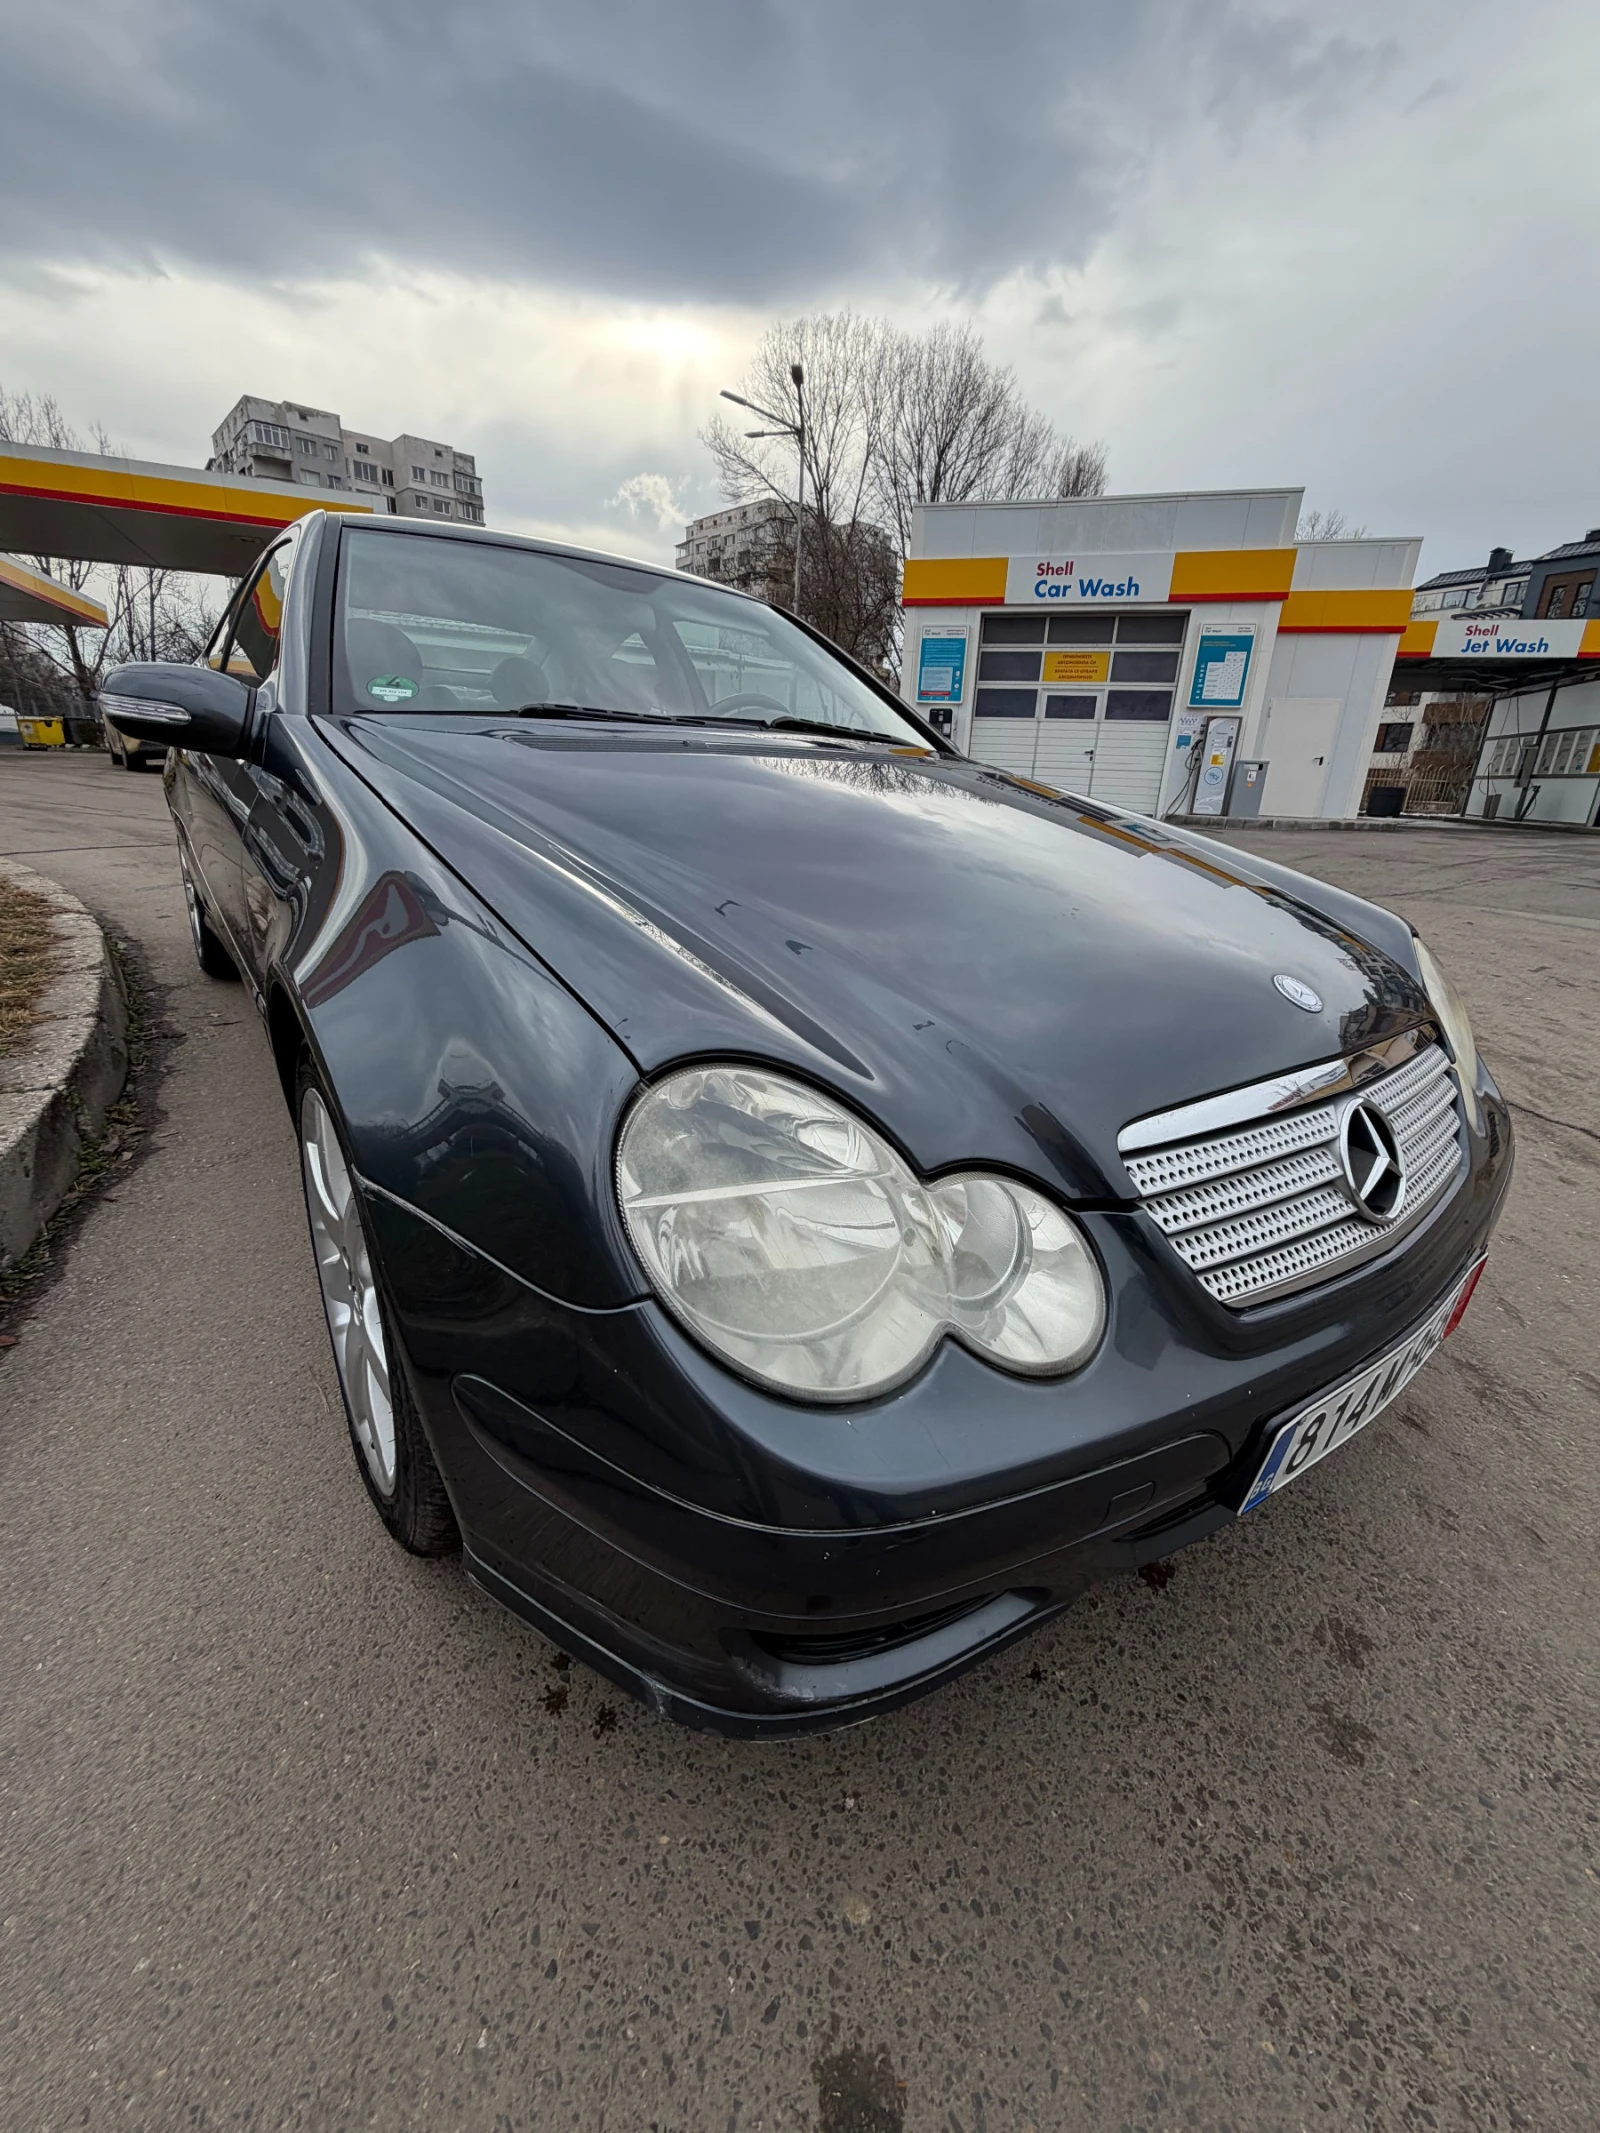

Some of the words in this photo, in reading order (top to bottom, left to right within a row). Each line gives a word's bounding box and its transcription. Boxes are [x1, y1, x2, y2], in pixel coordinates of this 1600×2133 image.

[1036, 561, 1074, 576] Shell
[1034, 579, 1072, 598] Car
[1079, 576, 1140, 597] Wash
[1465, 624, 1500, 636] Shell
[1461, 639, 1490, 653] Jet
[1496, 637, 1549, 653] Wash
[1250, 1472, 1276, 1497] BG
